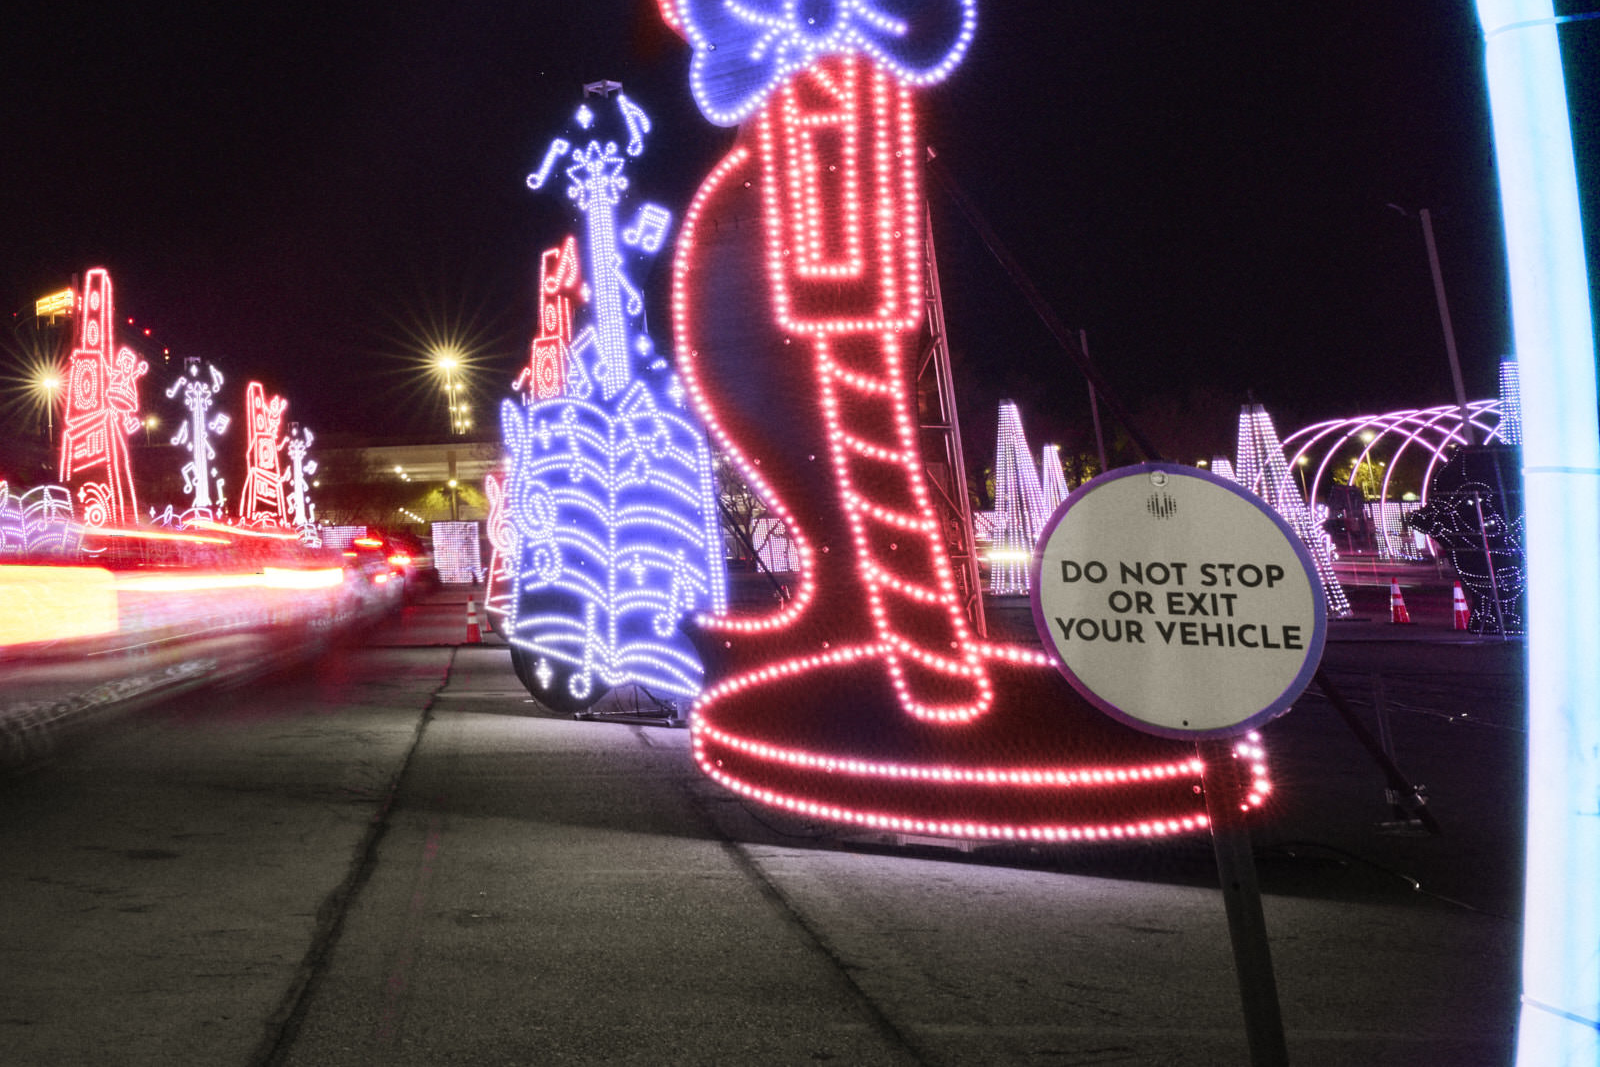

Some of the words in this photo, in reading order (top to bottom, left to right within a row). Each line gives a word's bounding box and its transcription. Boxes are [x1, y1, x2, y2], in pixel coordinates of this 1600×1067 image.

[1061, 560, 1108, 584] DO
[1119, 561, 1188, 586] NOT
[1200, 562, 1285, 589] STOP
[1107, 590, 1156, 615] OR
[1166, 591, 1238, 618] EXIT
[1055, 617, 1146, 644] YOUR
[1154, 620, 1304, 651] VEHICLE
